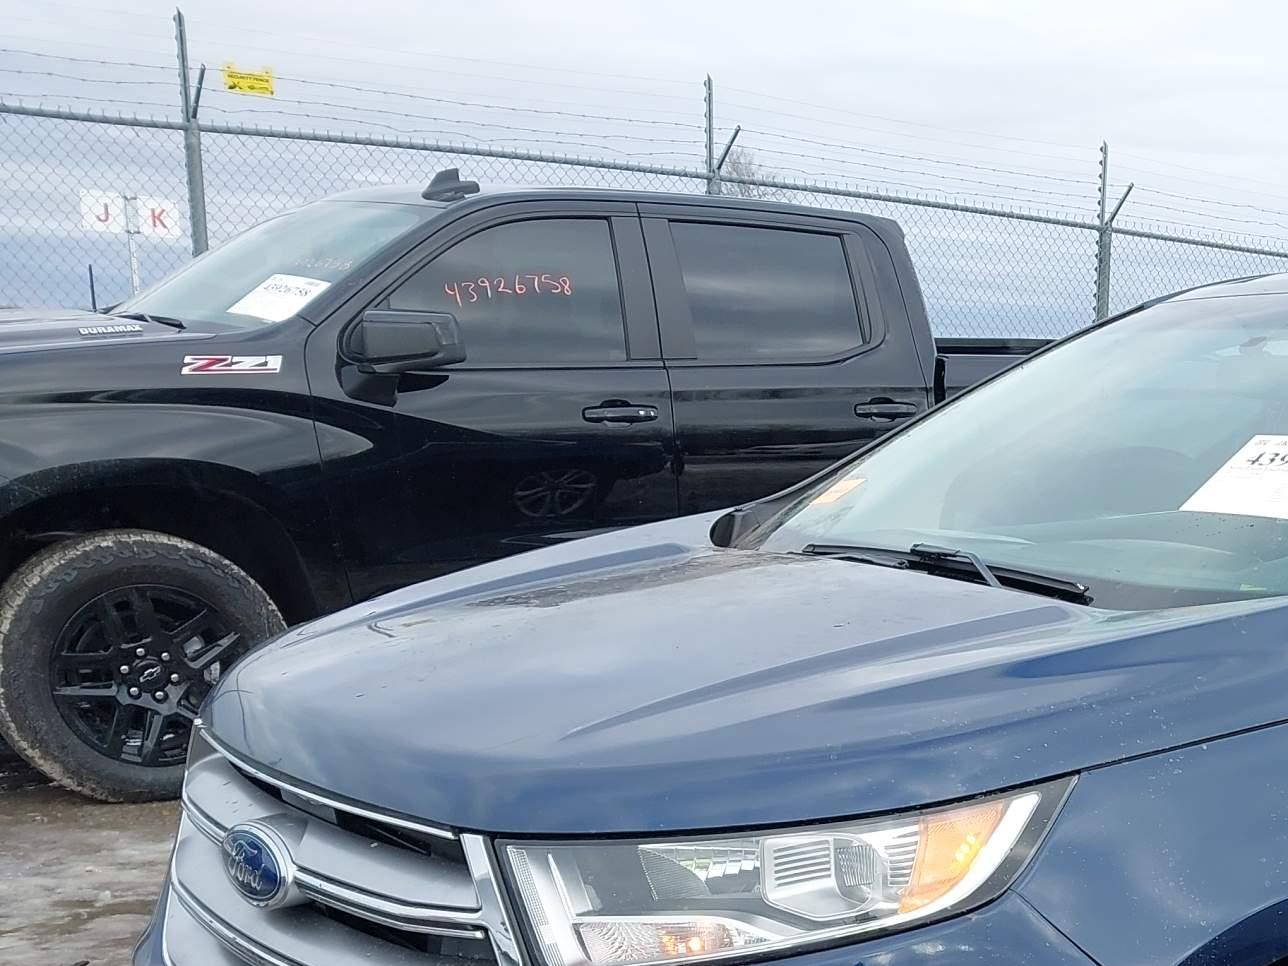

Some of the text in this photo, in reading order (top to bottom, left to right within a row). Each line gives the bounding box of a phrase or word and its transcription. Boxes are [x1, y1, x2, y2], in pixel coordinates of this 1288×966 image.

[96, 203, 109, 222] J
[151, 208, 167, 229] K
[444, 274, 572, 307] 43926758
[79, 325, 143, 335] DURAMAX
[226, 840, 265, 890] Ford
